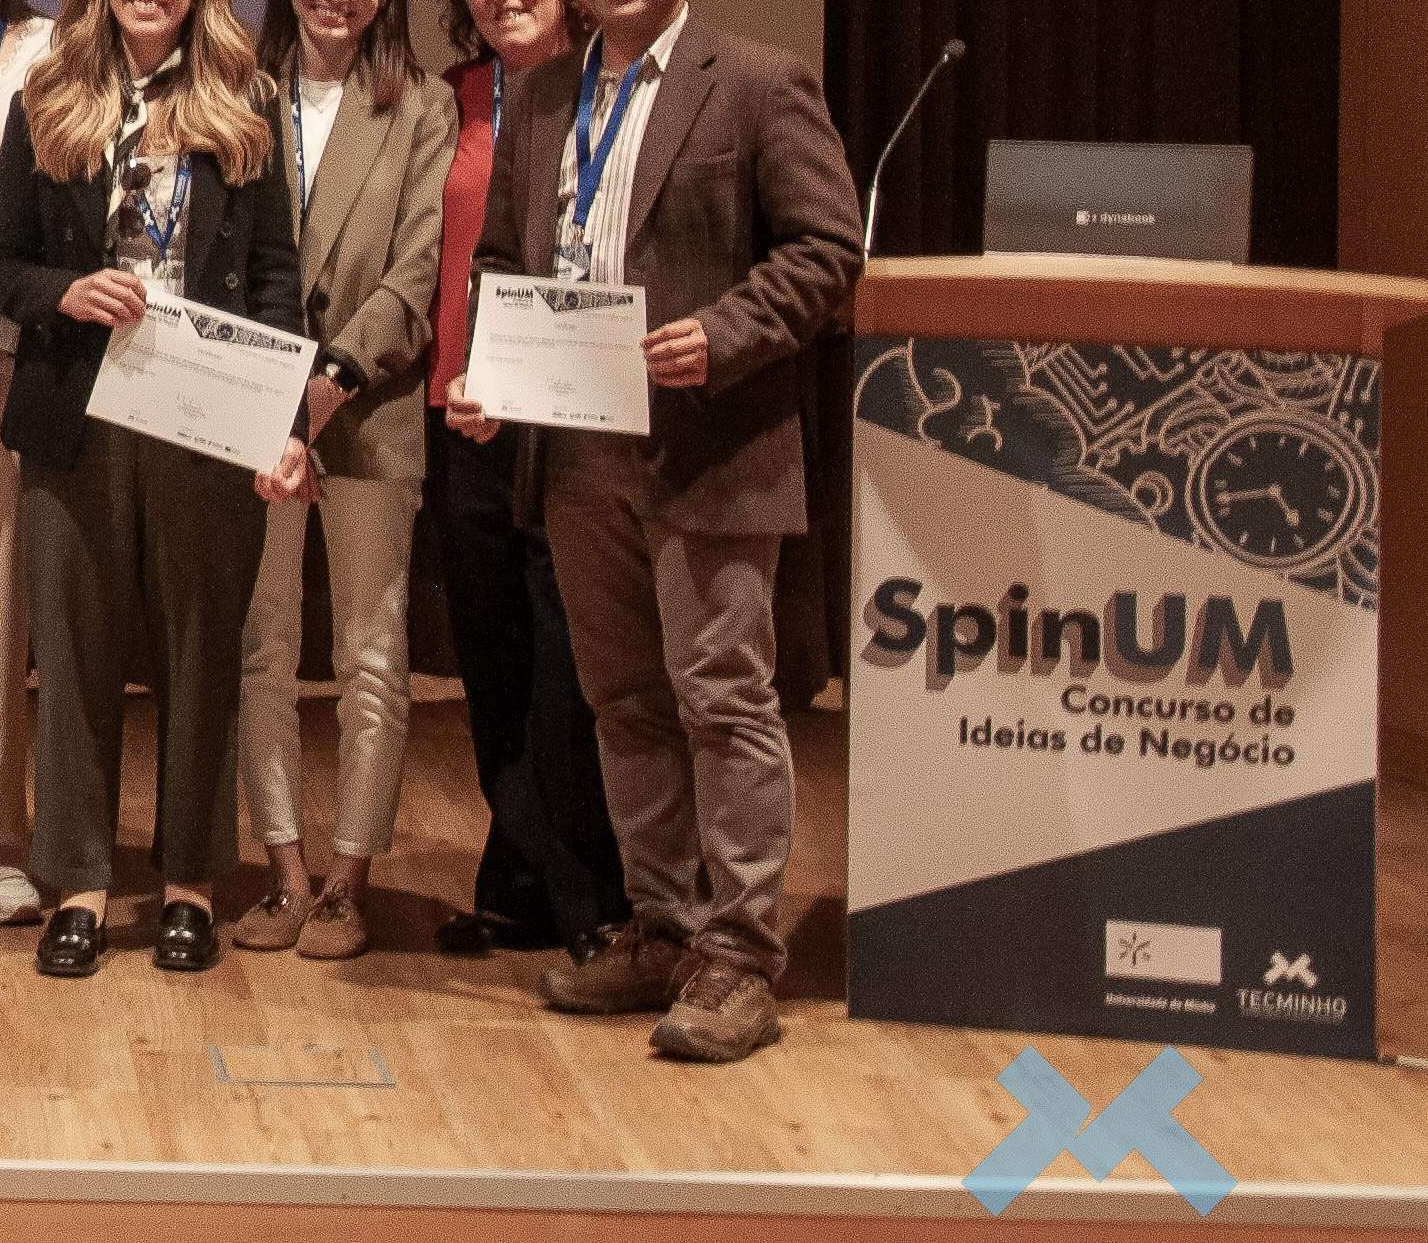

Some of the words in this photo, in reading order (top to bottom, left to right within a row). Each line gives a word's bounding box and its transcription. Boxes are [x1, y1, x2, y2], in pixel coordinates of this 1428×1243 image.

[145, 302, 182, 319] pinUM
[860, 576, 1294, 692] SpinUM
[1061, 685, 1235, 726] Concurso
[1248, 696, 1294, 728] de
[959, 717, 1066, 752] Ideias
[1080, 725, 1124, 755] de
[1139, 728, 1294, 769] Negócio
[1239, 989, 1346, 1016] TECMINHO
